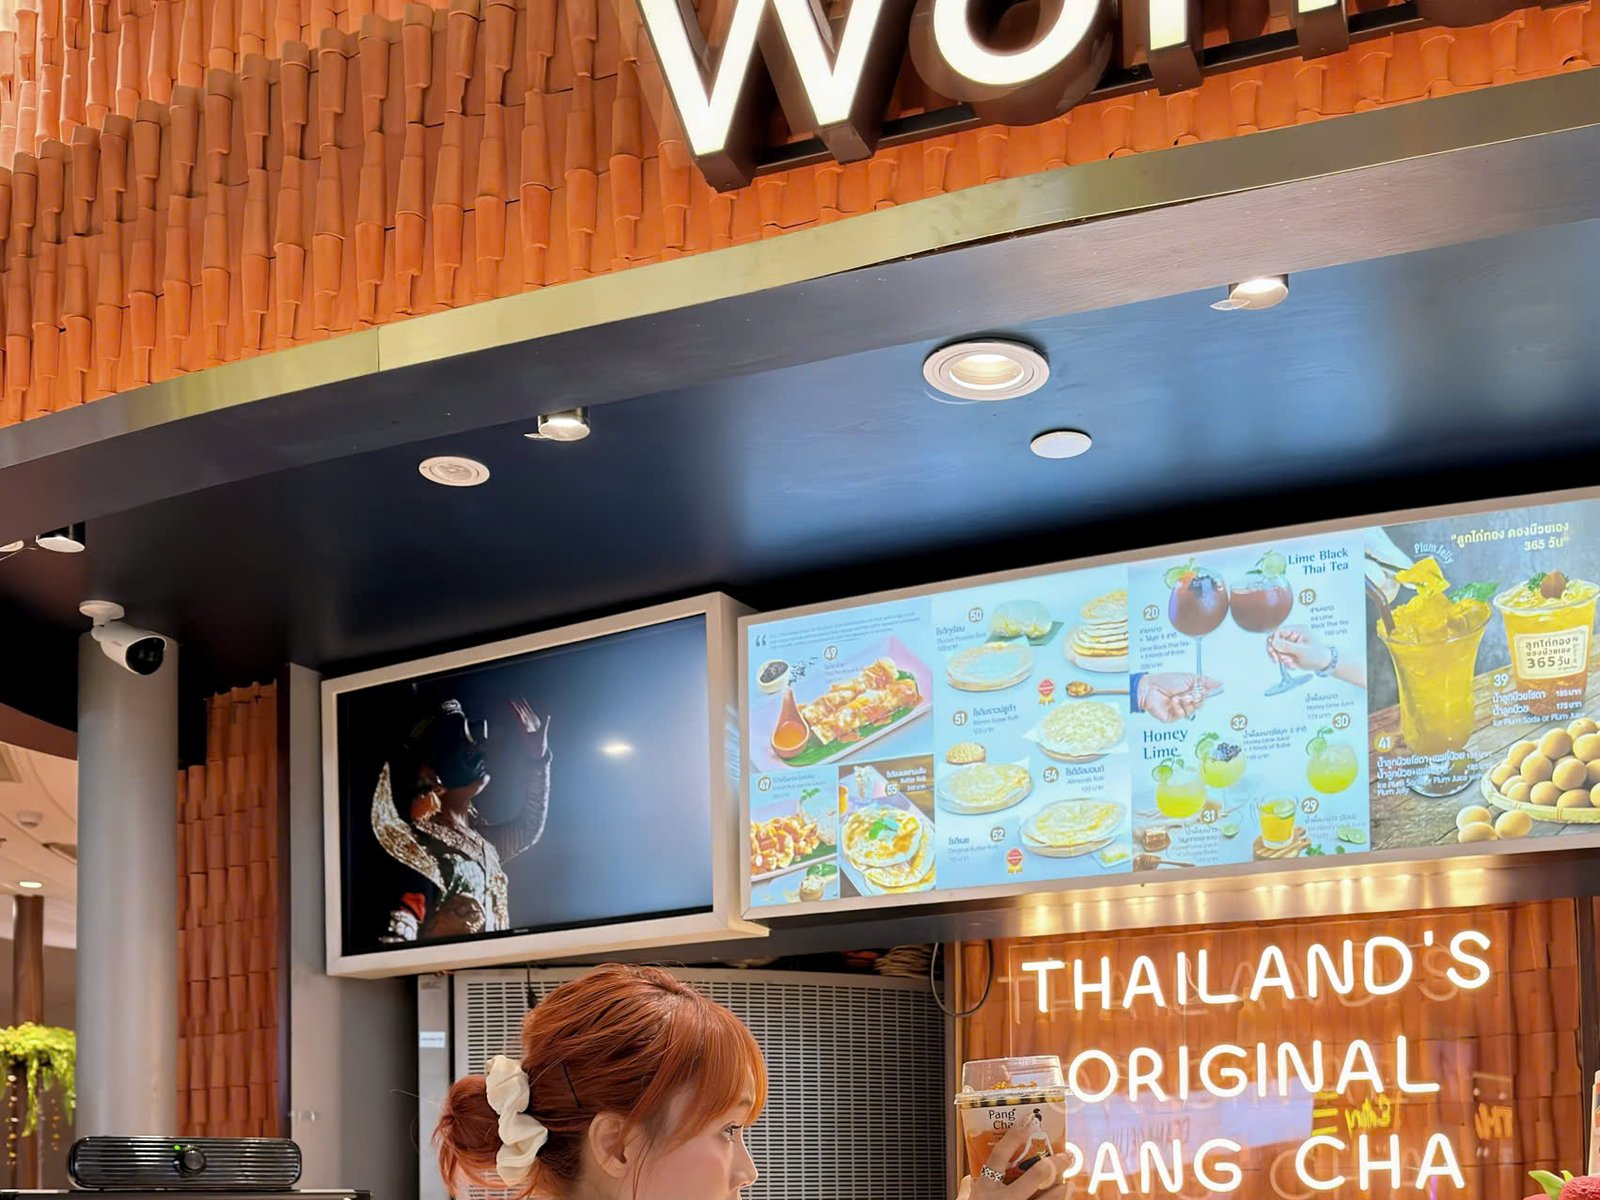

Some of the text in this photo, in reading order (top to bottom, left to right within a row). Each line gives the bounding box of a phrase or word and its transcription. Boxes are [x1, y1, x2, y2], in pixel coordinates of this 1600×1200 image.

[1524, 539, 1545, 551] 365
[1288, 547, 1349, 565] Lime Black
[1414, 542, 1455, 565] Plum Jelly
[1302, 561, 1349, 575] Thai Tea
[1301, 591, 1314, 604] 18
[1145, 607, 1158, 620] 20
[1527, 656, 1555, 669] 365
[1494, 673, 1508, 687] 39
[954, 713, 965, 725] 51
[1232, 716, 1246, 729] 32
[1335, 714, 1349, 728] 30
[1144, 729, 1189, 743] Honey
[1378, 736, 1392, 749] 41
[1144, 746, 1182, 760] Lime
[1303, 799, 1317, 812] 29
[1203, 810, 1215, 822] 31
[1022, 930, 1493, 1014] THAILAND'S
[1068, 1035, 1440, 1104] ORIGINAL
[988, 1108, 1017, 1121] Pang
[1295, 1132, 1466, 1192] CHA
